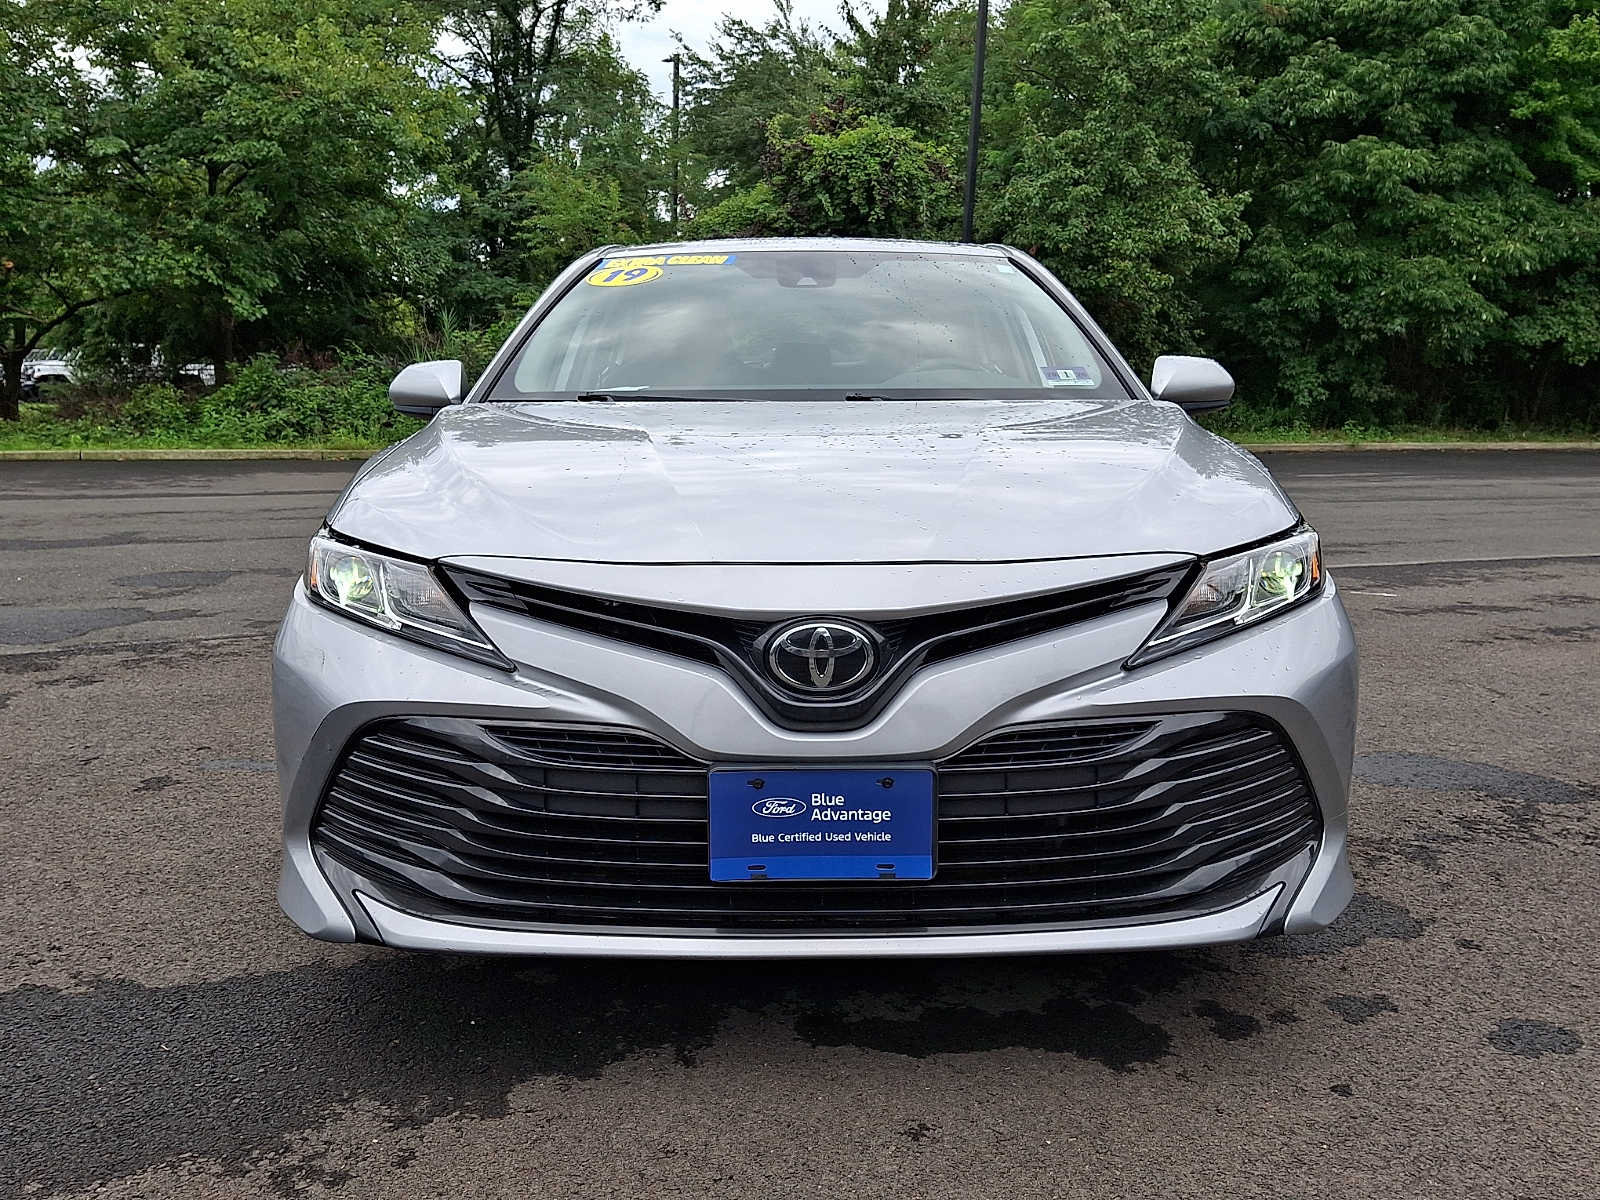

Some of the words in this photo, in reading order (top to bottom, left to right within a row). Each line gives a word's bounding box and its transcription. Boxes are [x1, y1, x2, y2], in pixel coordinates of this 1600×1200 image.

[667, 255, 728, 265] CLEAN
[603, 267, 648, 282] 19
[811, 793, 844, 806] Blue
[762, 800, 796, 815] Ford
[811, 808, 892, 823] Advantage
[751, 833, 775, 843] Blue
[777, 831, 822, 842] Certified
[825, 832, 851, 842] Used
[854, 831, 892, 842] Vehicle
